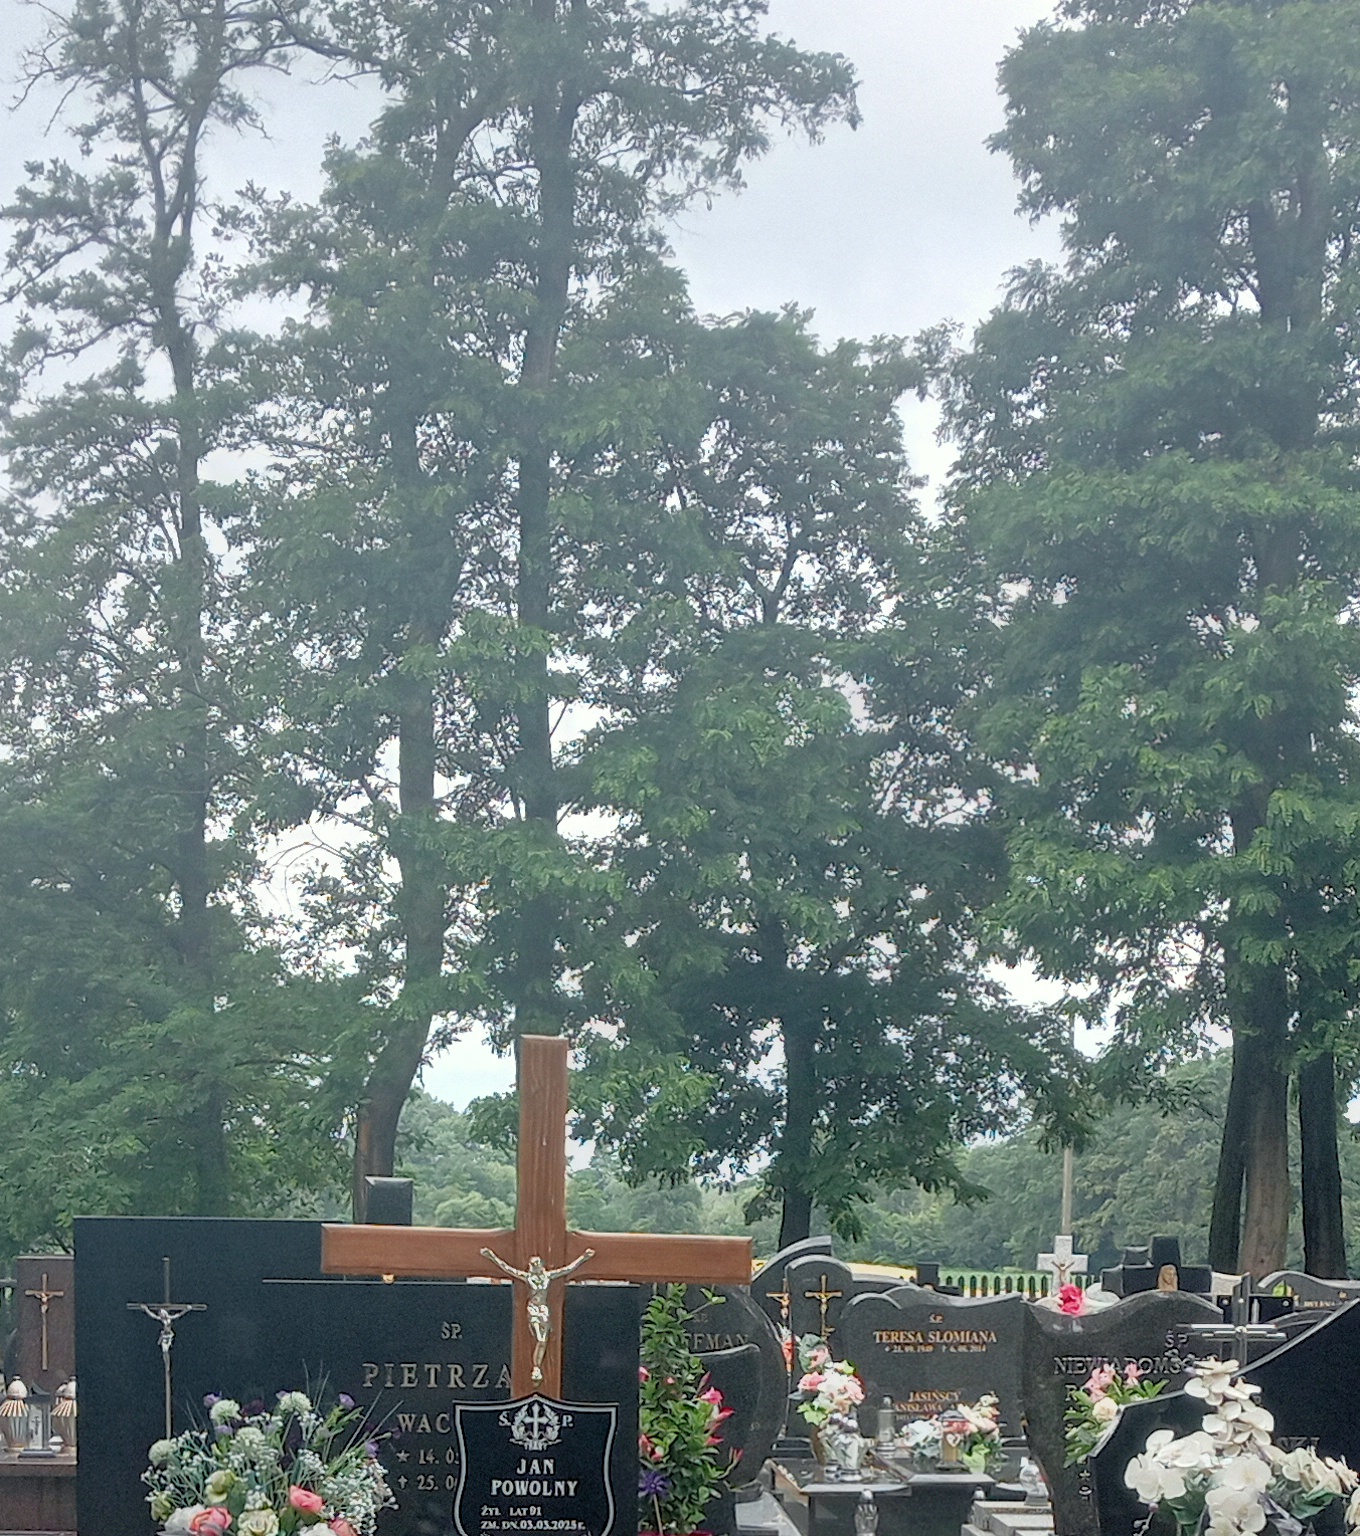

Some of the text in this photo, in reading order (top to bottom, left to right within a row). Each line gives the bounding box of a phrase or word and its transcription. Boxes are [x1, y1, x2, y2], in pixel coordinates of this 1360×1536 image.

[873, 1330, 924, 1344] TERESA
[516, 1458, 555, 1475] JAN
[490, 1479, 579, 1497] POWOLNY
[509, 1507, 529, 1517] LAT
